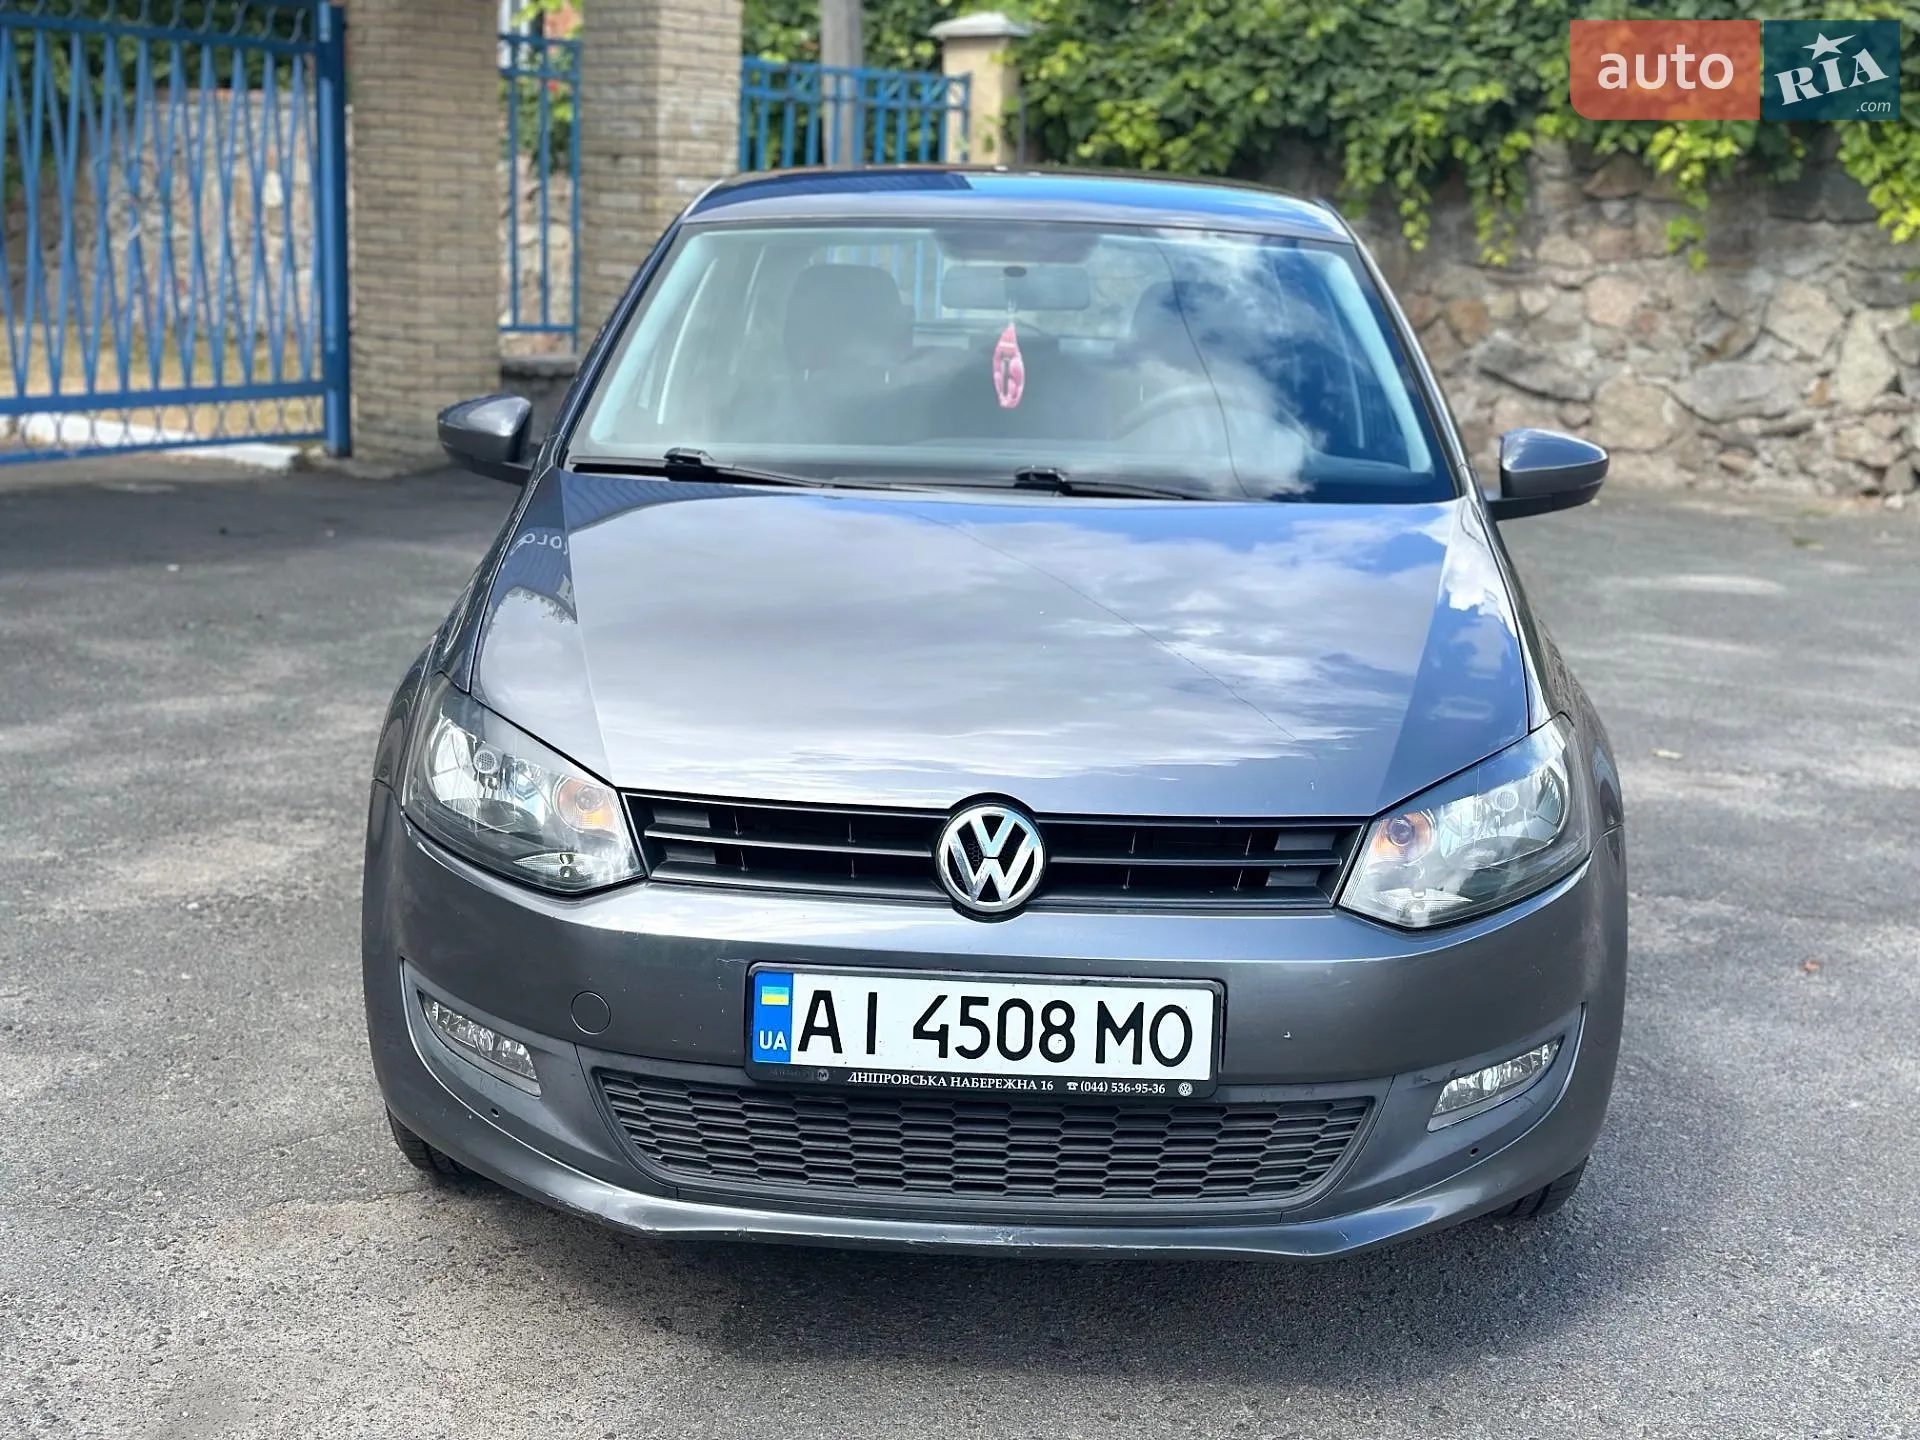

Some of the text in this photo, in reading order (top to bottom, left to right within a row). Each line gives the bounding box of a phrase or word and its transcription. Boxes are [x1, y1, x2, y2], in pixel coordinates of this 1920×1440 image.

[797, 989, 1193, 1068] AI 4508 MO
[759, 1029, 787, 1051] UA
[847, 1071, 1054, 1091] ДНІПРОВСЬКА НАБЕРЕЖНА 16
[1080, 1081, 1166, 1095] (044) 536-95-36
